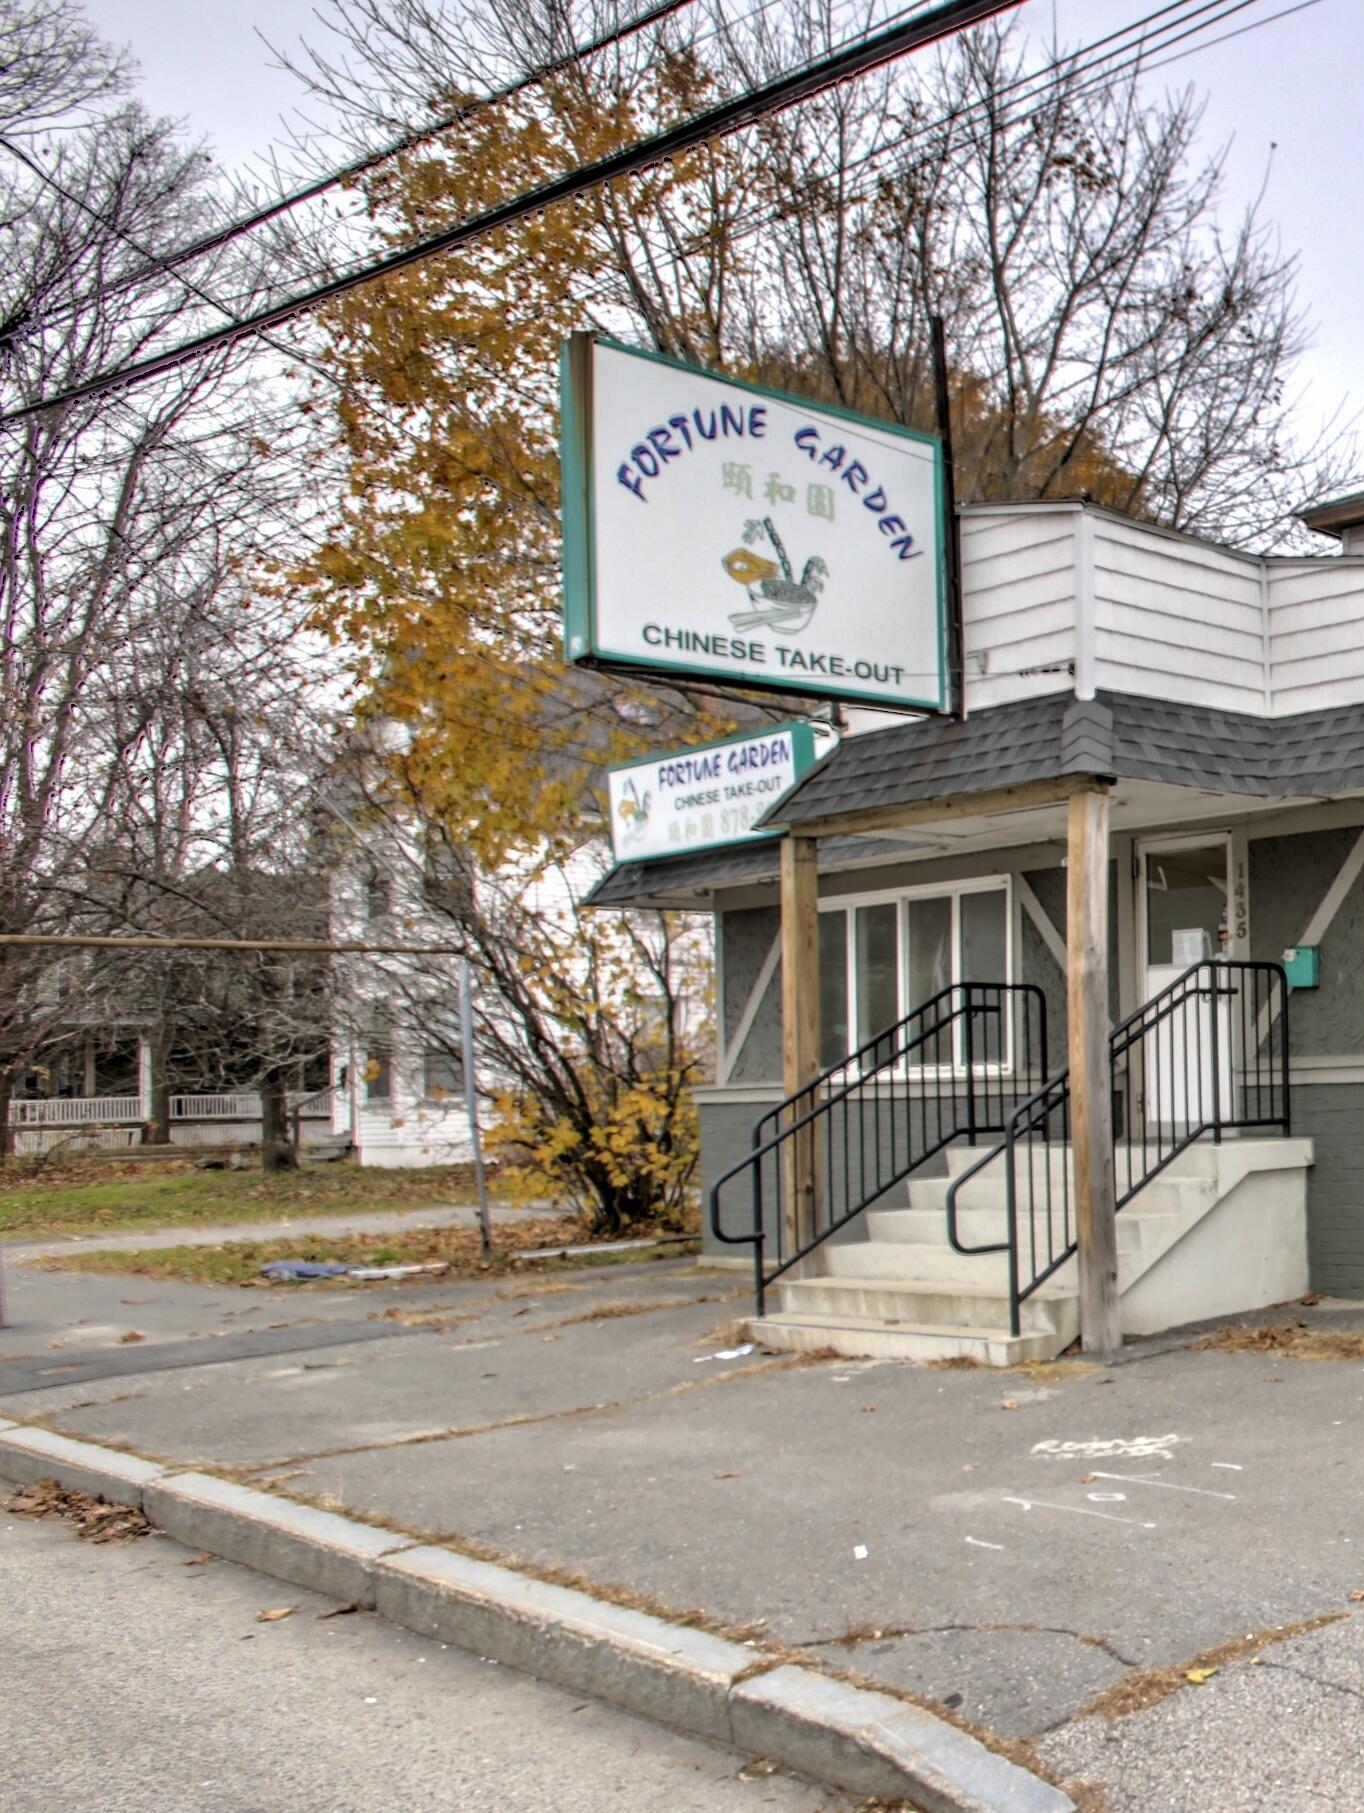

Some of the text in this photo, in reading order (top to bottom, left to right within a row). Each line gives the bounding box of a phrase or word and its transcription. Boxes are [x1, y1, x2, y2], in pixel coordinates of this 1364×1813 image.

[616, 402, 924, 563] FORTUNE GARDEN
[642, 625, 905, 685] CHINESE TAKE-OUT
[658, 738, 790, 791] FORTUNE GARDEN
[674, 775, 783, 811] CHINESE TAKE-OUT
[1233, 861, 1248, 940] 1435
